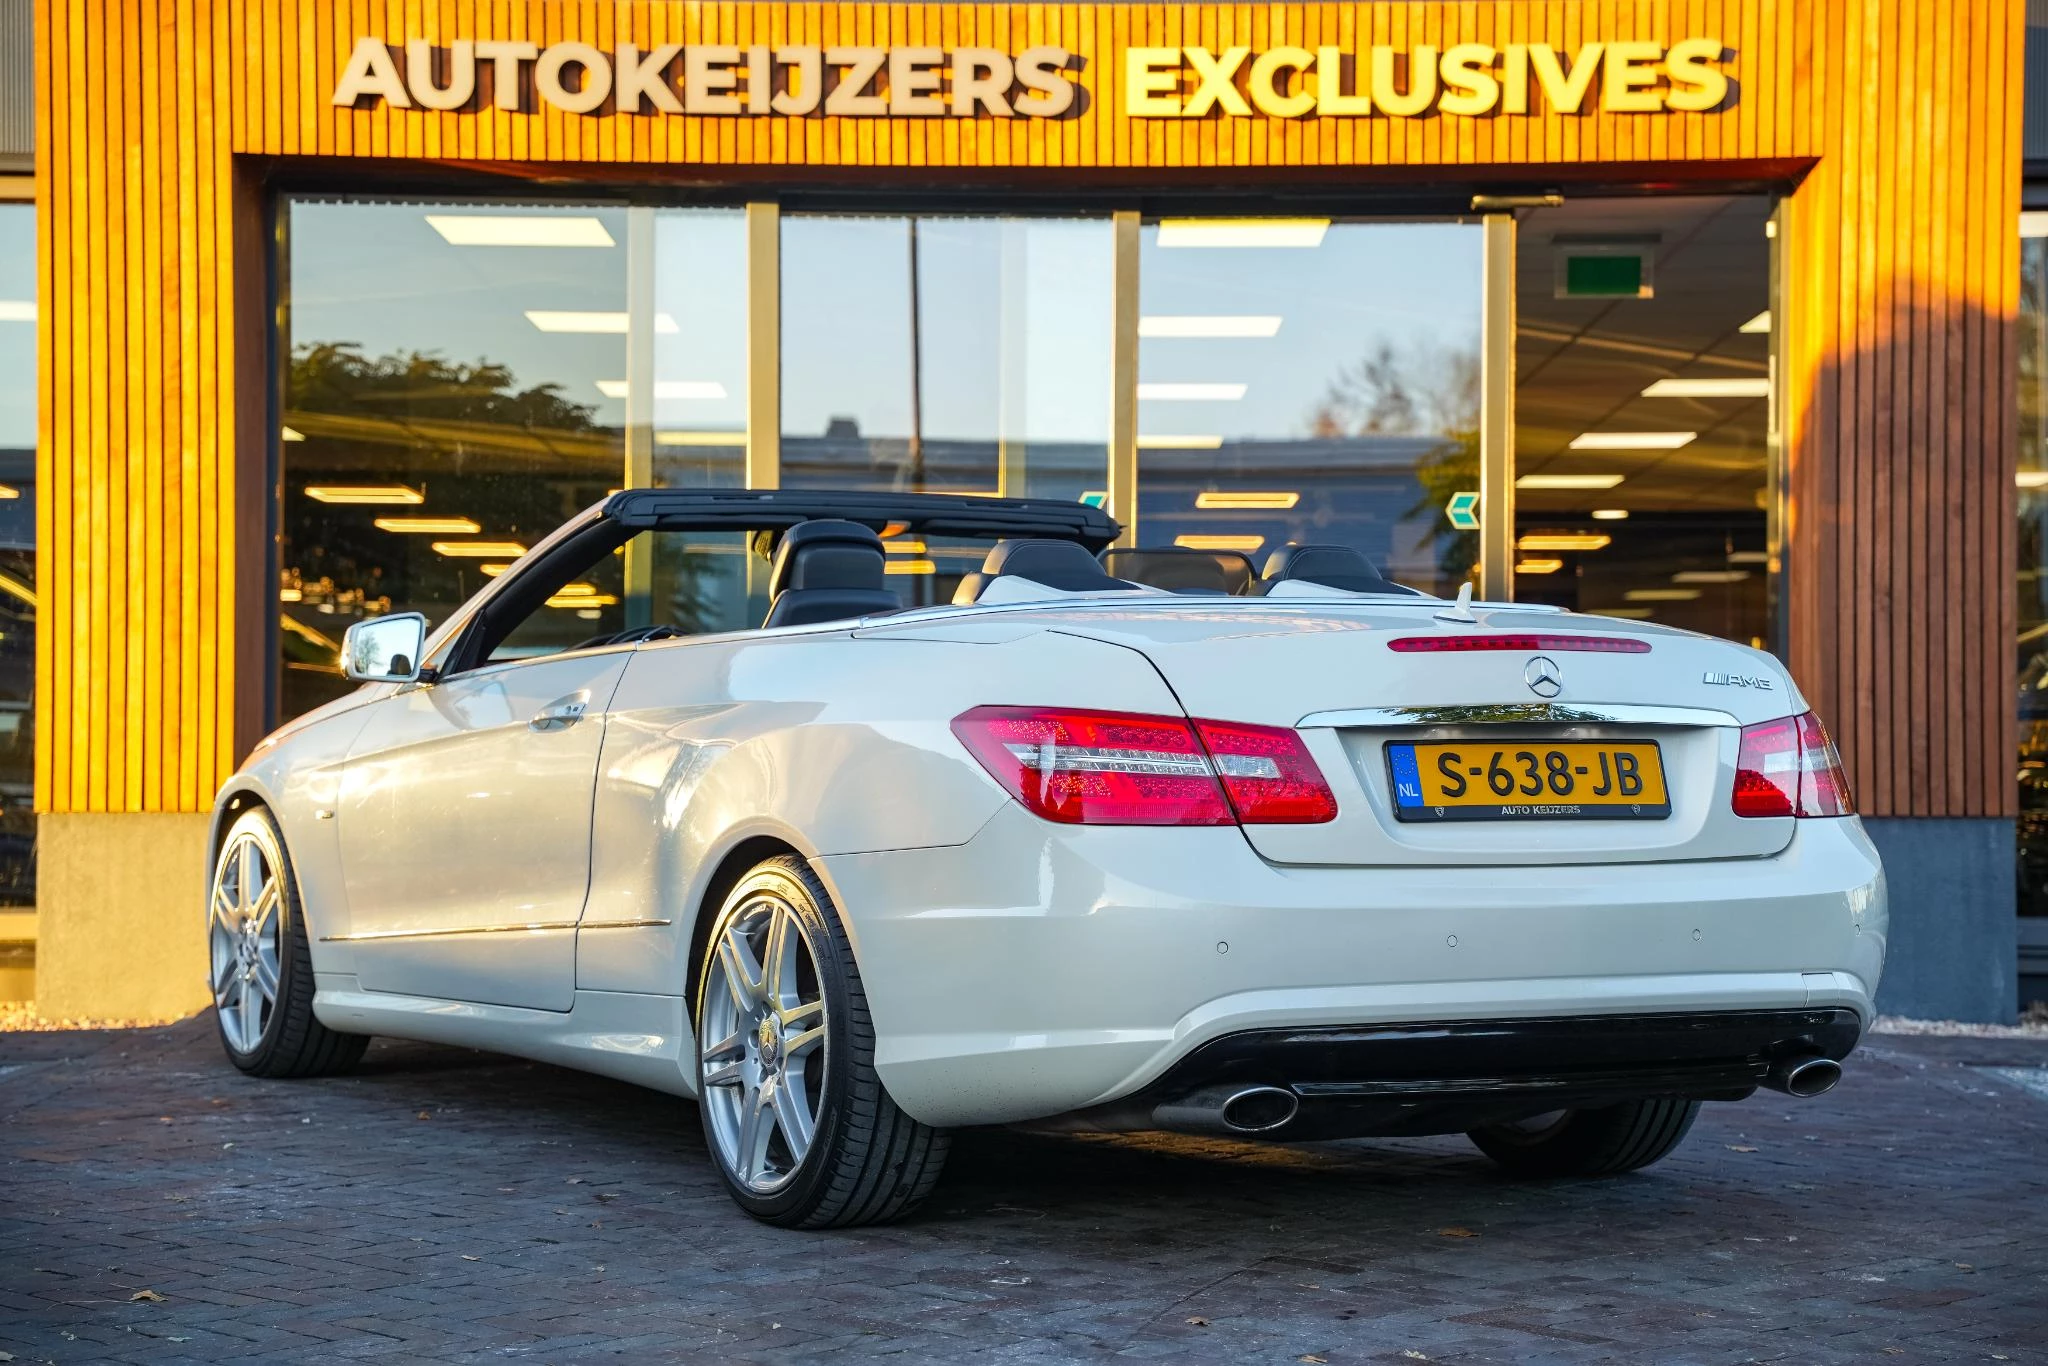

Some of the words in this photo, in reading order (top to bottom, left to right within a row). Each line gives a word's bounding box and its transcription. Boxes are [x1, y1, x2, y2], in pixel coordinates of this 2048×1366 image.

[332, 36, 1074, 117] AUTOKEIJZERS
[1125, 37, 1727, 117] EXCLUSIVES
[1437, 751, 1643, 798] S-638-JB
[1399, 783, 1419, 798] NL
[1501, 805, 1531, 815] AUTO
[1533, 805, 1581, 815] KEIJZERS
